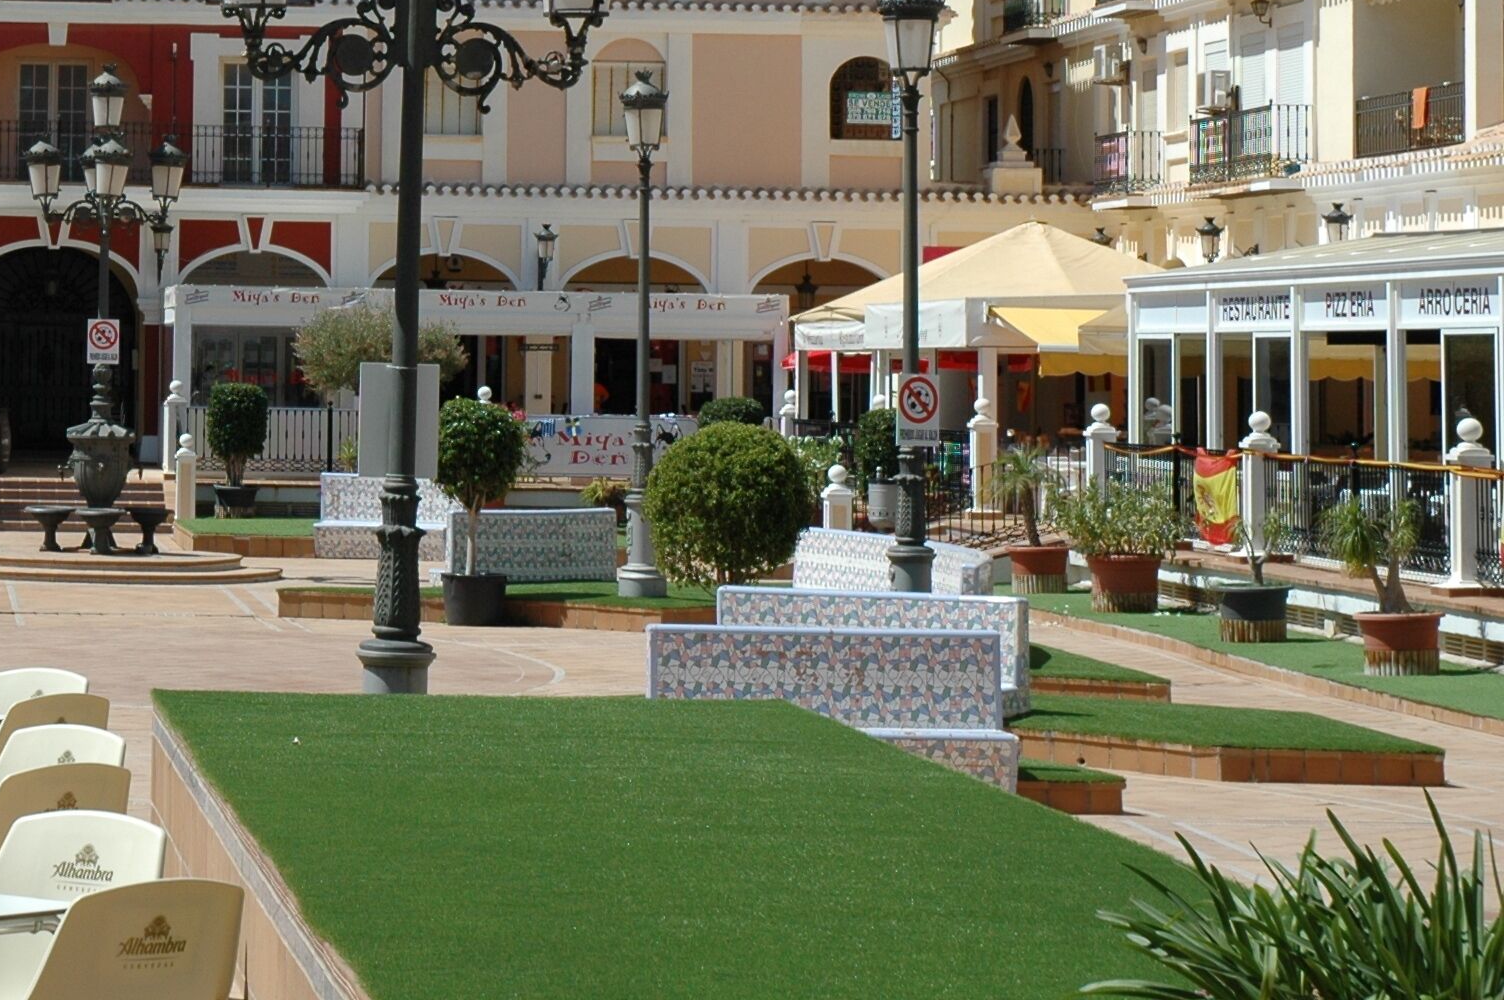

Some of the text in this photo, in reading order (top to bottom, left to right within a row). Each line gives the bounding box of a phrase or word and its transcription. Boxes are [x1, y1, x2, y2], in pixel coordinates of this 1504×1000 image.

[496, 296, 527, 307] Den
[648, 298, 727, 312] iya's Den
[1222, 295, 1291, 322] RESTAURANTE
[557, 431, 633, 451] Miya'
[568, 450, 628, 466] Den
[51, 861, 114, 882] Alhambra
[116, 935, 187, 958] Alhambra
